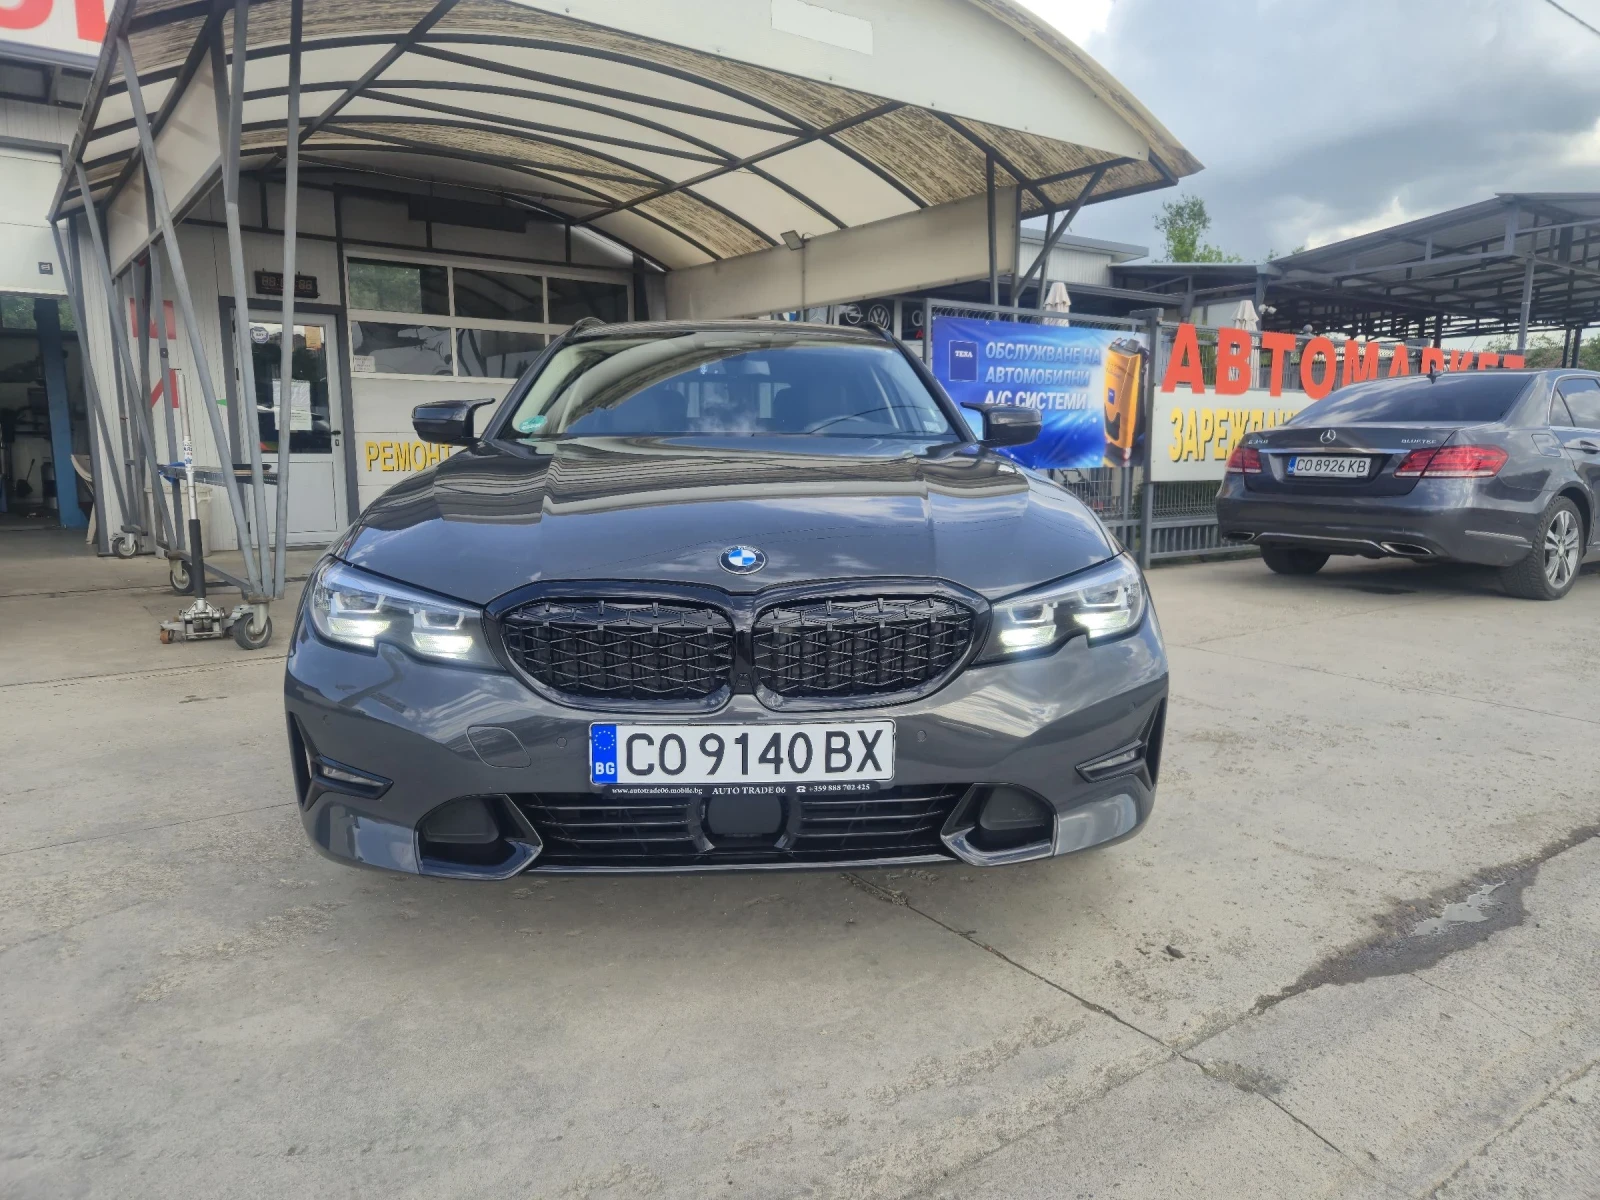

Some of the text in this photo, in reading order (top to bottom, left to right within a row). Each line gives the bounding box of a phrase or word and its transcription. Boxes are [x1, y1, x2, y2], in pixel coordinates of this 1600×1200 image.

[954, 350, 974, 358] TEXA
[986, 342, 1102, 365] ОБСЛУЖВАНЕ НА
[1160, 322, 1525, 400] АВТОМАР
[985, 366, 1090, 385] АВТОМОБИЛНИ
[1169, 407, 1300, 461] ЗАРЕЖ
[1296, 459, 1313, 472] CO
[1314, 459, 1345, 473] 8926
[1347, 460, 1367, 473] KB
[626, 729, 883, 775] CO 9140 BX
[595, 762, 615, 775] BG
[612, 787, 703, 795] www.autotrade06.mobile.bg
[712, 785, 786, 795] AUTO TRADE 06
[857, 783, 870, 791] 425
